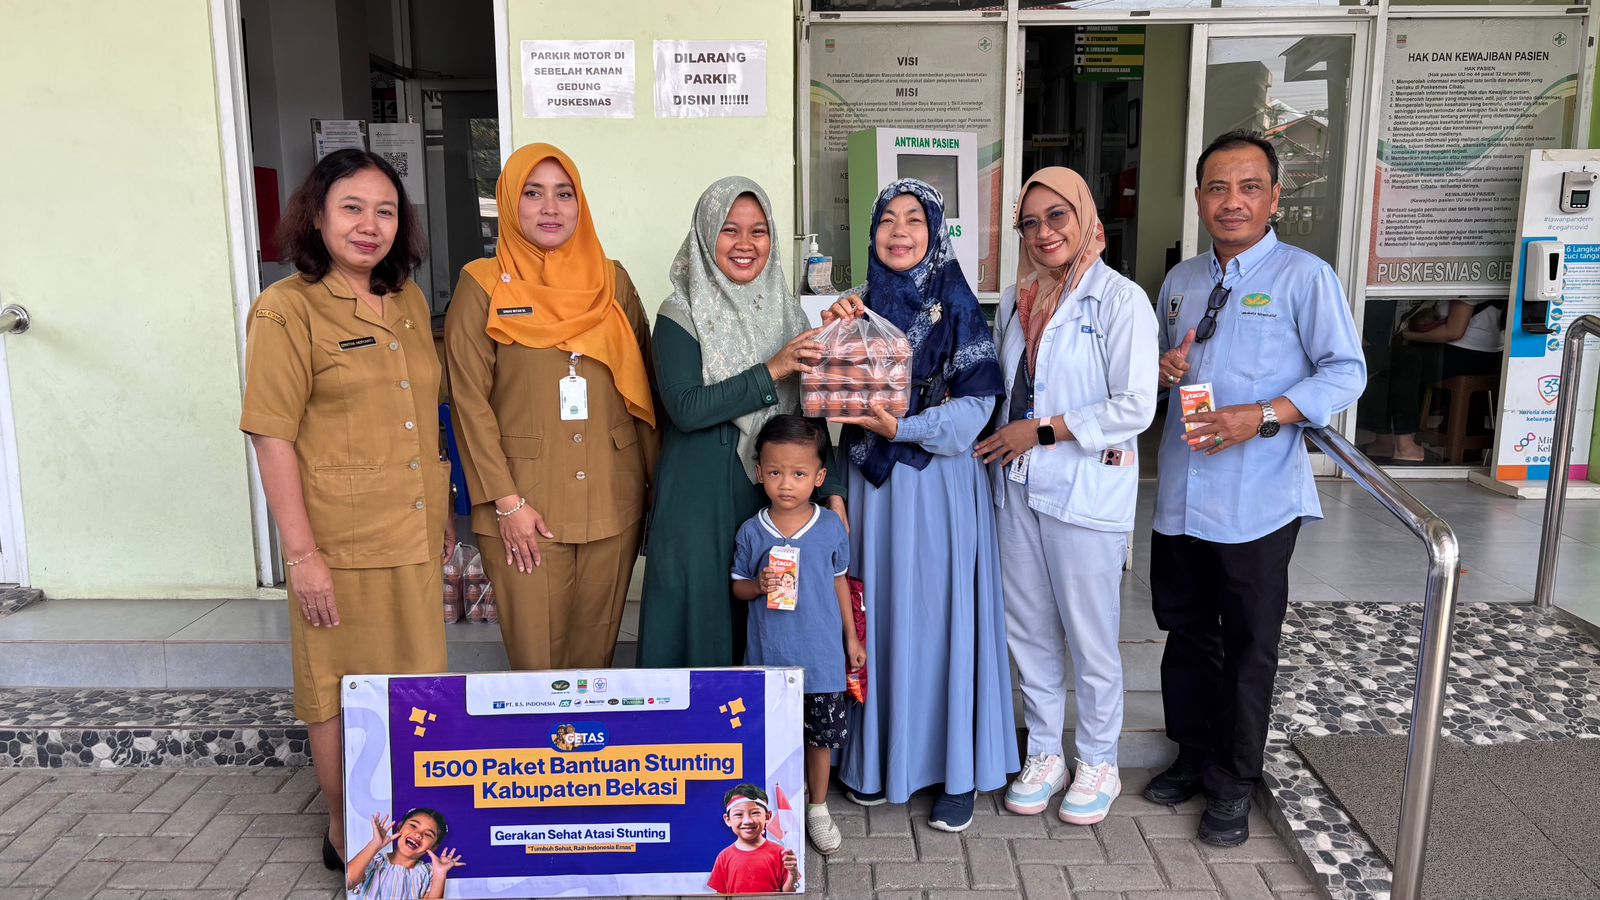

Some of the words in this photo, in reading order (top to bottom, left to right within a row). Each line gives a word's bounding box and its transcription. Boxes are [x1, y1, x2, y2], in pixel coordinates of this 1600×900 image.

[674, 53, 746, 63] DILARANG
[897, 57, 918, 66] VISI
[1408, 53, 1429, 62] HAK
[1432, 53, 1452, 62] DAN
[1455, 52, 1512, 61] KEWAJIBAN
[1515, 52, 1549, 60] PASIEN
[684, 74, 736, 84] PARKIR
[896, 88, 918, 97] MISI
[673, 95, 716, 105] DISINI
[895, 137, 930, 147] ANTRIAN
[932, 138, 959, 148] PASIEN
[1377, 262, 1481, 282] PUSKESMAS
[1486, 262, 1512, 281] CIB
[1544, 378, 1560, 394] 33
[566, 732, 604, 744] GETAS
[422, 759, 477, 778] 1500
[483, 757, 545, 776] Paket
[550, 756, 640, 775] Bantuan
[645, 753, 735, 774] Stunting
[483, 781, 601, 801] Kabupaten
[606, 778, 677, 796] Bekasi
[495, 830, 546, 841] Gerakan
[548, 829, 582, 840] Sehat
[584, 828, 614, 839] Atasi
[616, 828, 665, 840] Stunting
